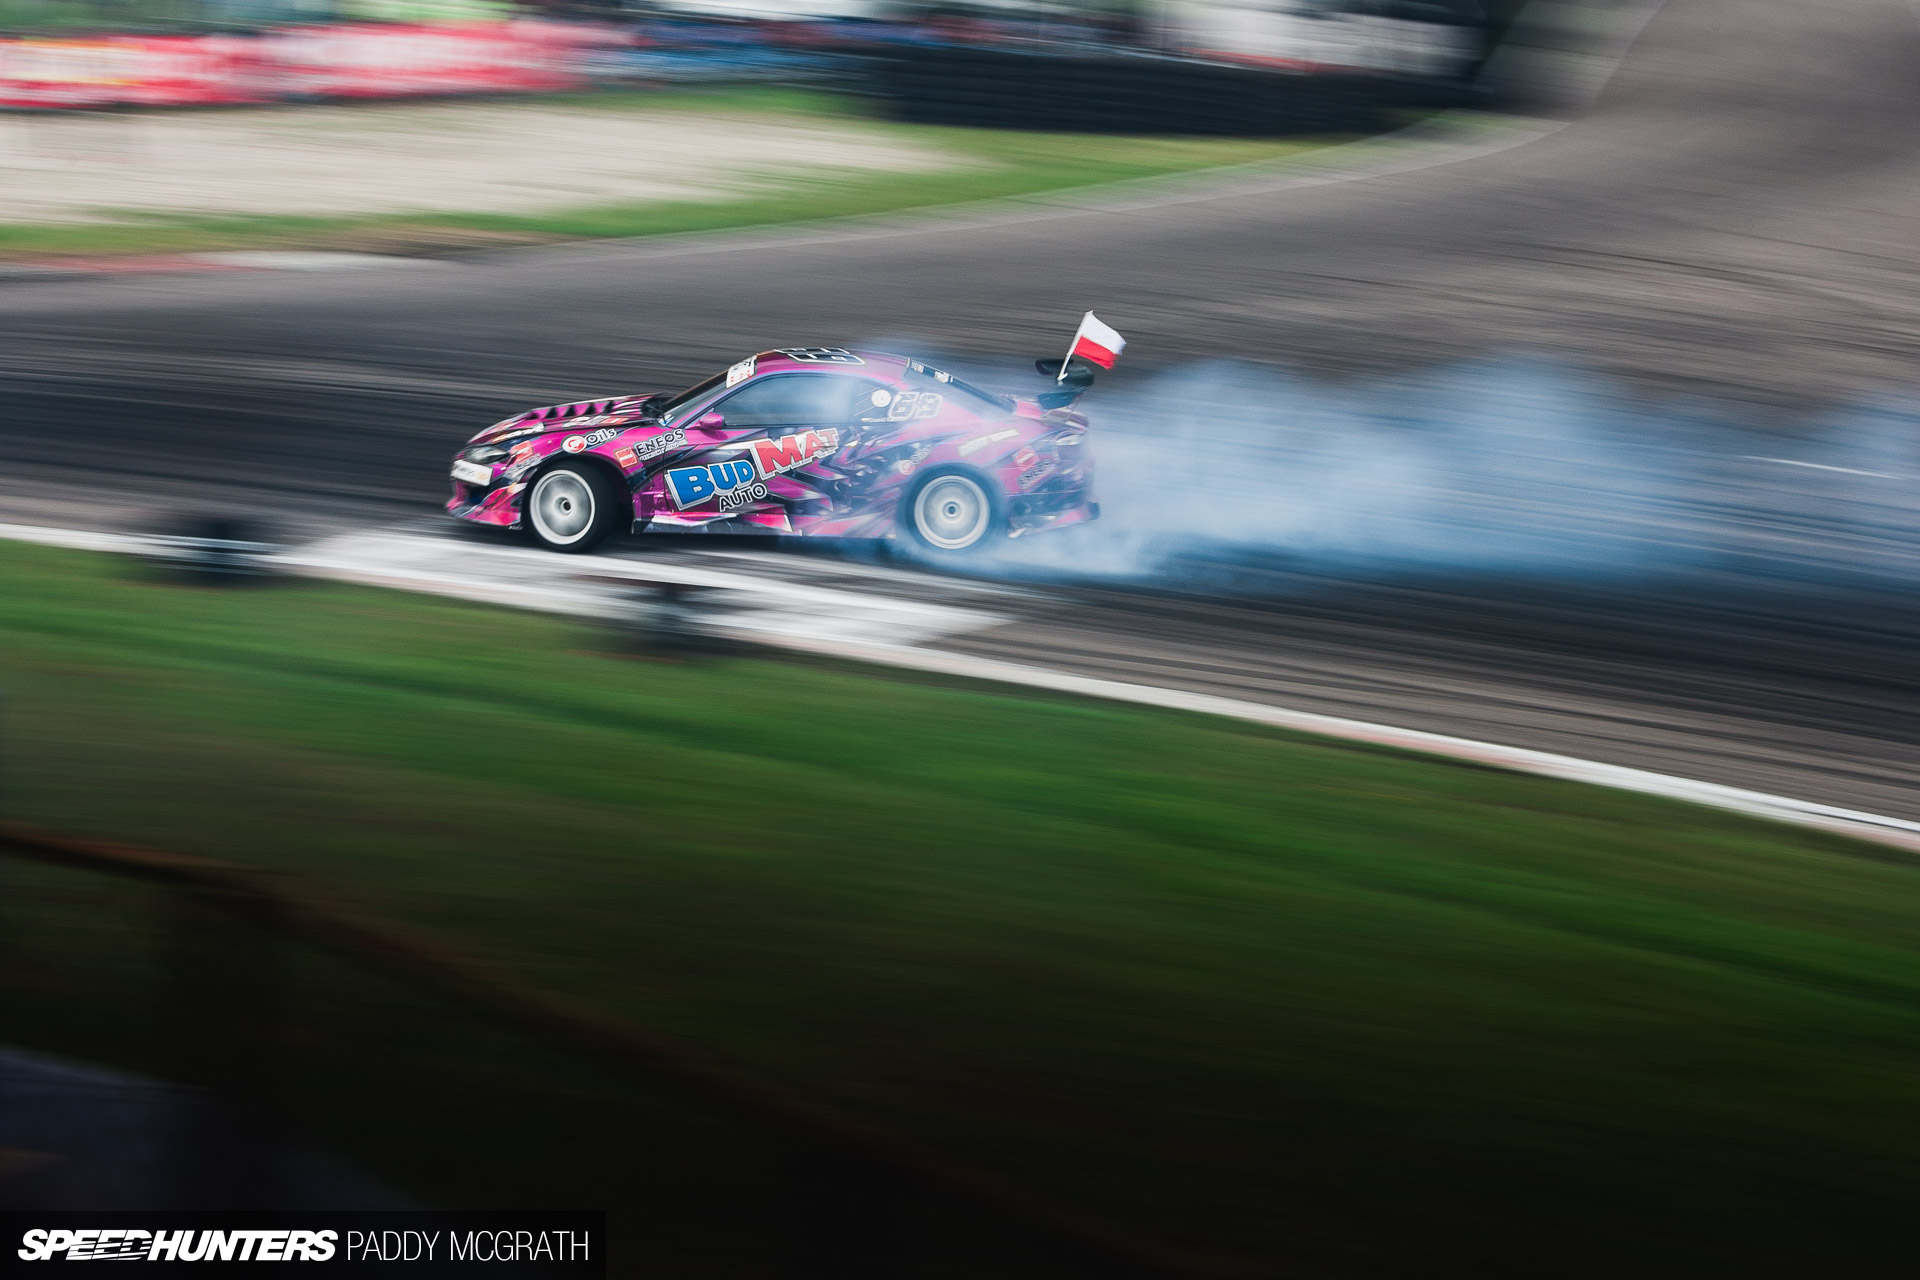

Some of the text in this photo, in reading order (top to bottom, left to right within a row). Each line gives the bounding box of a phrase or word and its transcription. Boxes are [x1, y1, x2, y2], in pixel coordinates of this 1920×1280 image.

[585, 428, 617, 446] Oils
[635, 428, 685, 456] ENEOS
[667, 429, 839, 508] BUD MAT
[720, 483, 767, 511] AUTO
